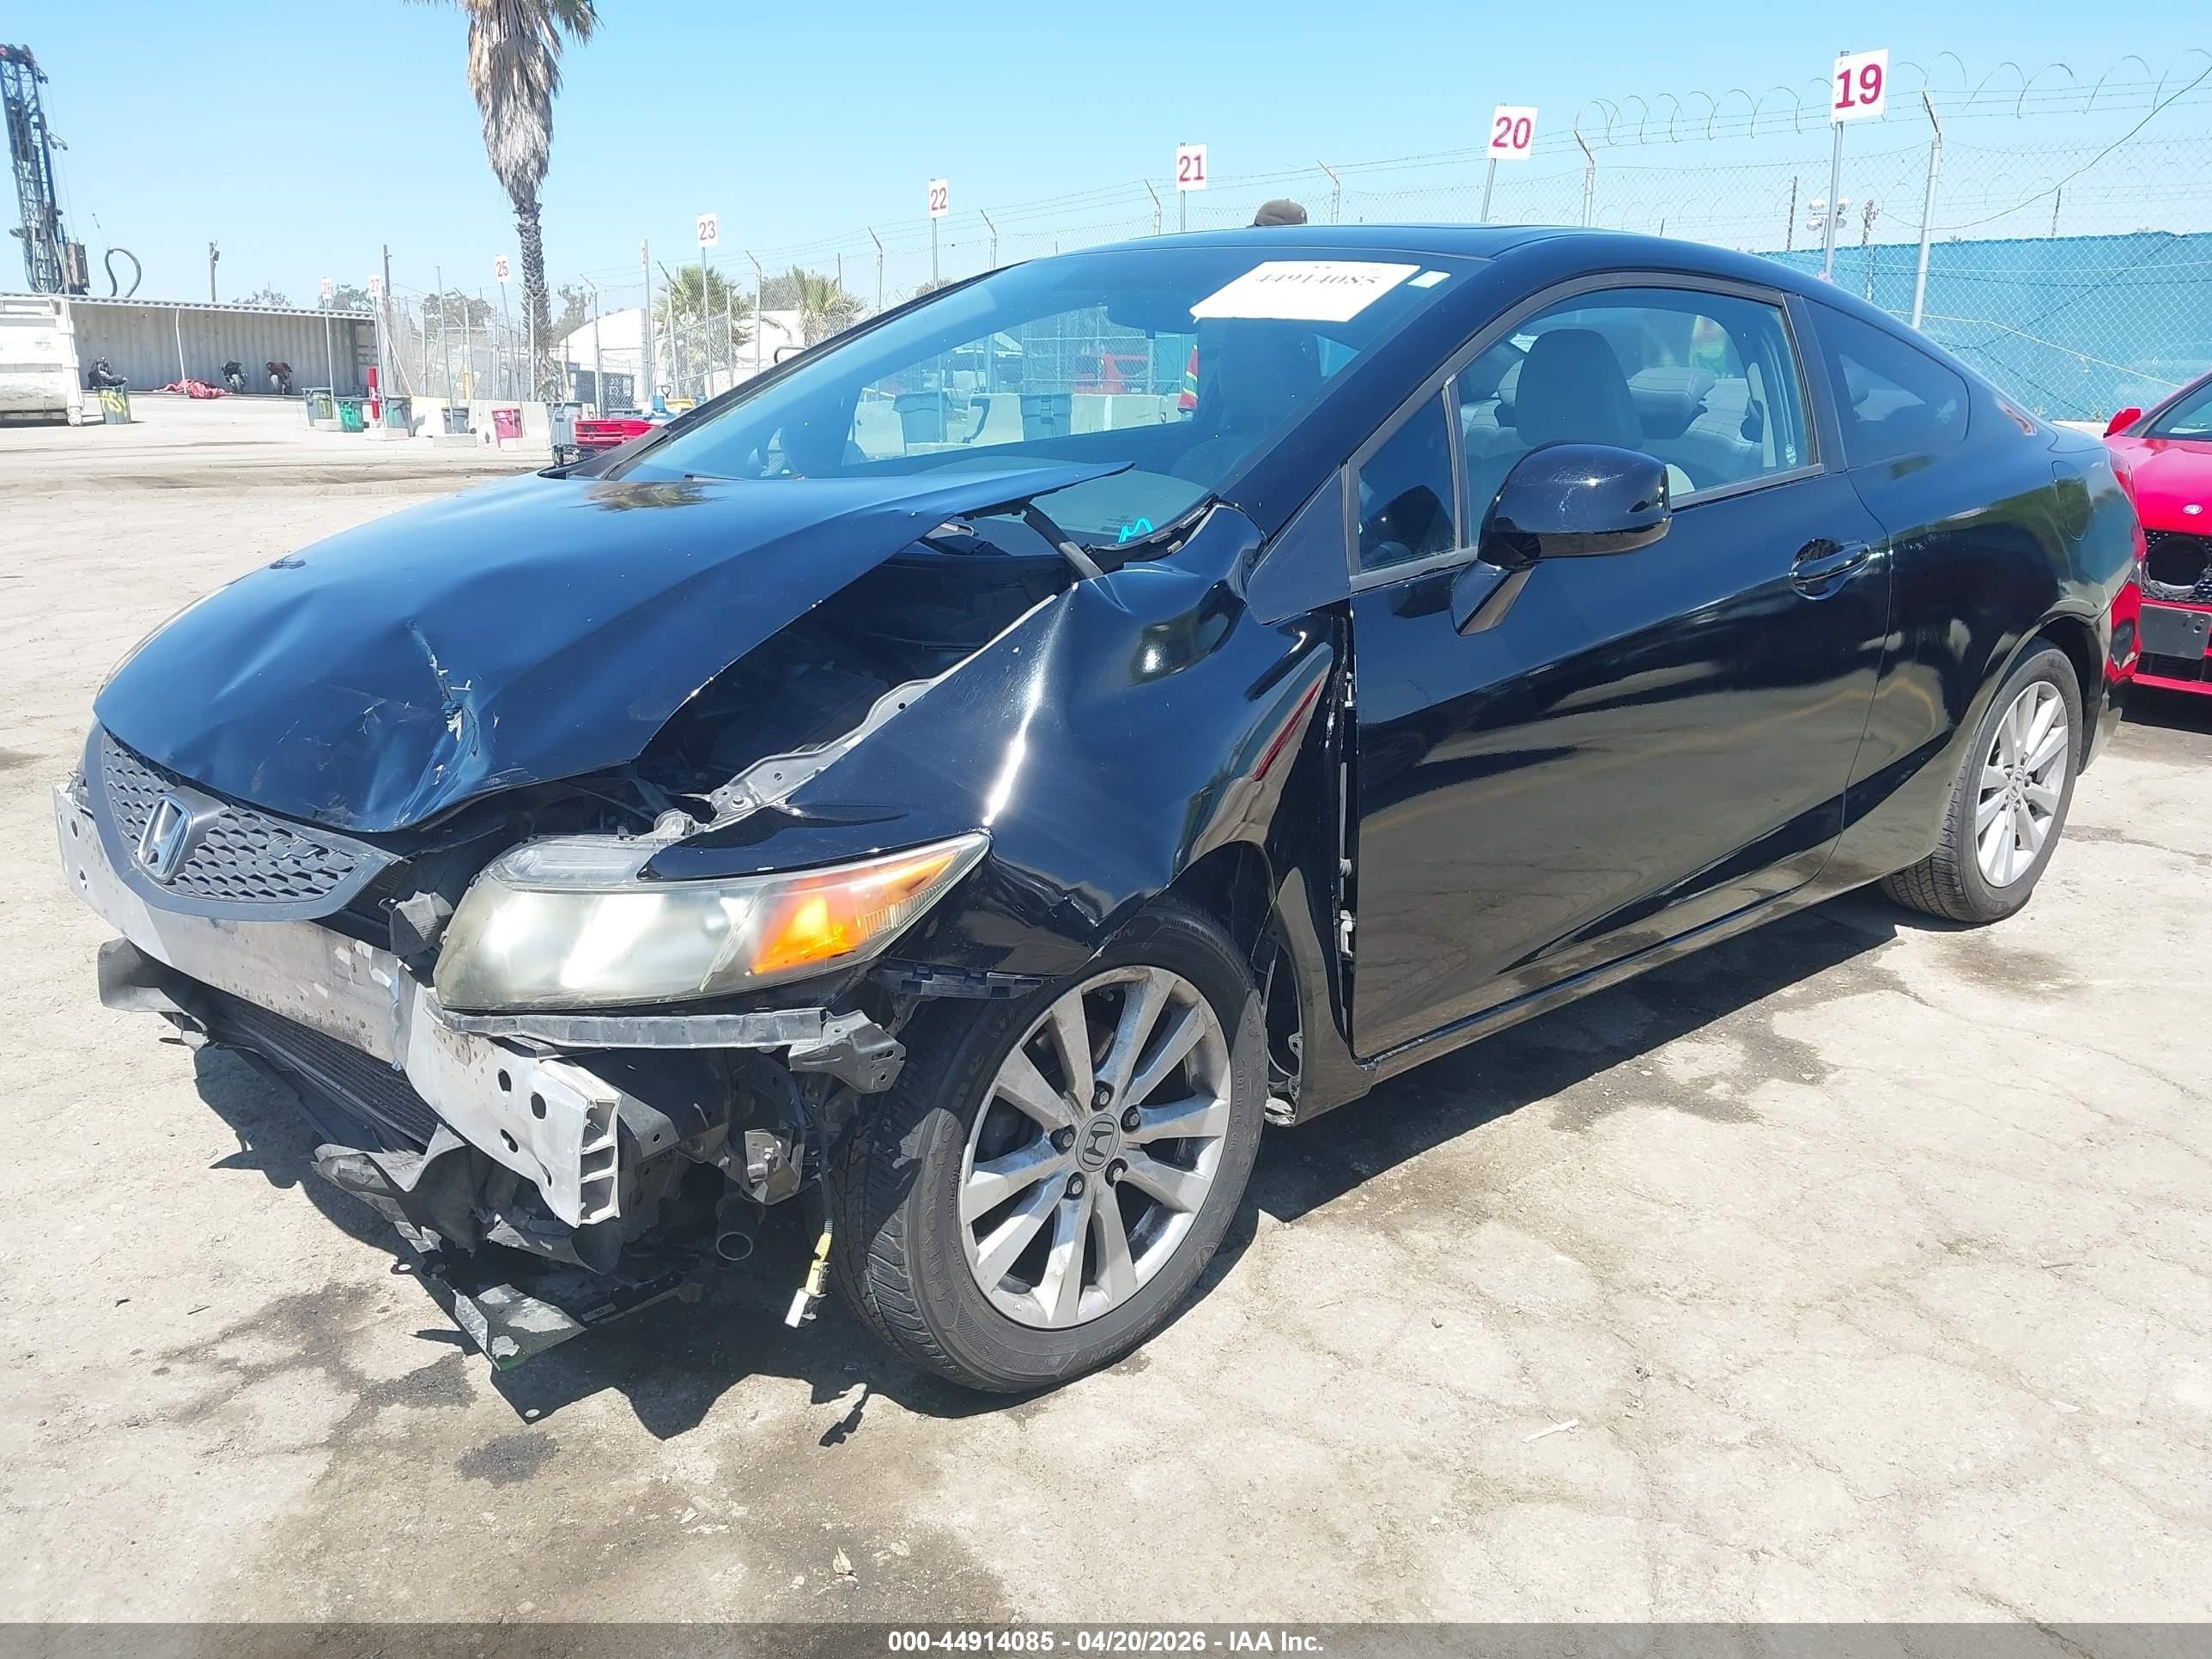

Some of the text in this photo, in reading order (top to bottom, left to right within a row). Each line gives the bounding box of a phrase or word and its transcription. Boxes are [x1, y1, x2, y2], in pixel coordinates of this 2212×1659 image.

[1834, 64, 1883, 109] 19
[1492, 116, 1532, 149] 20
[1178, 154, 1205, 182] 21
[930, 186, 947, 211] 22
[698, 220, 716, 241] 23
[495, 260, 509, 277] 25
[370, 278, 380, 293] 27
